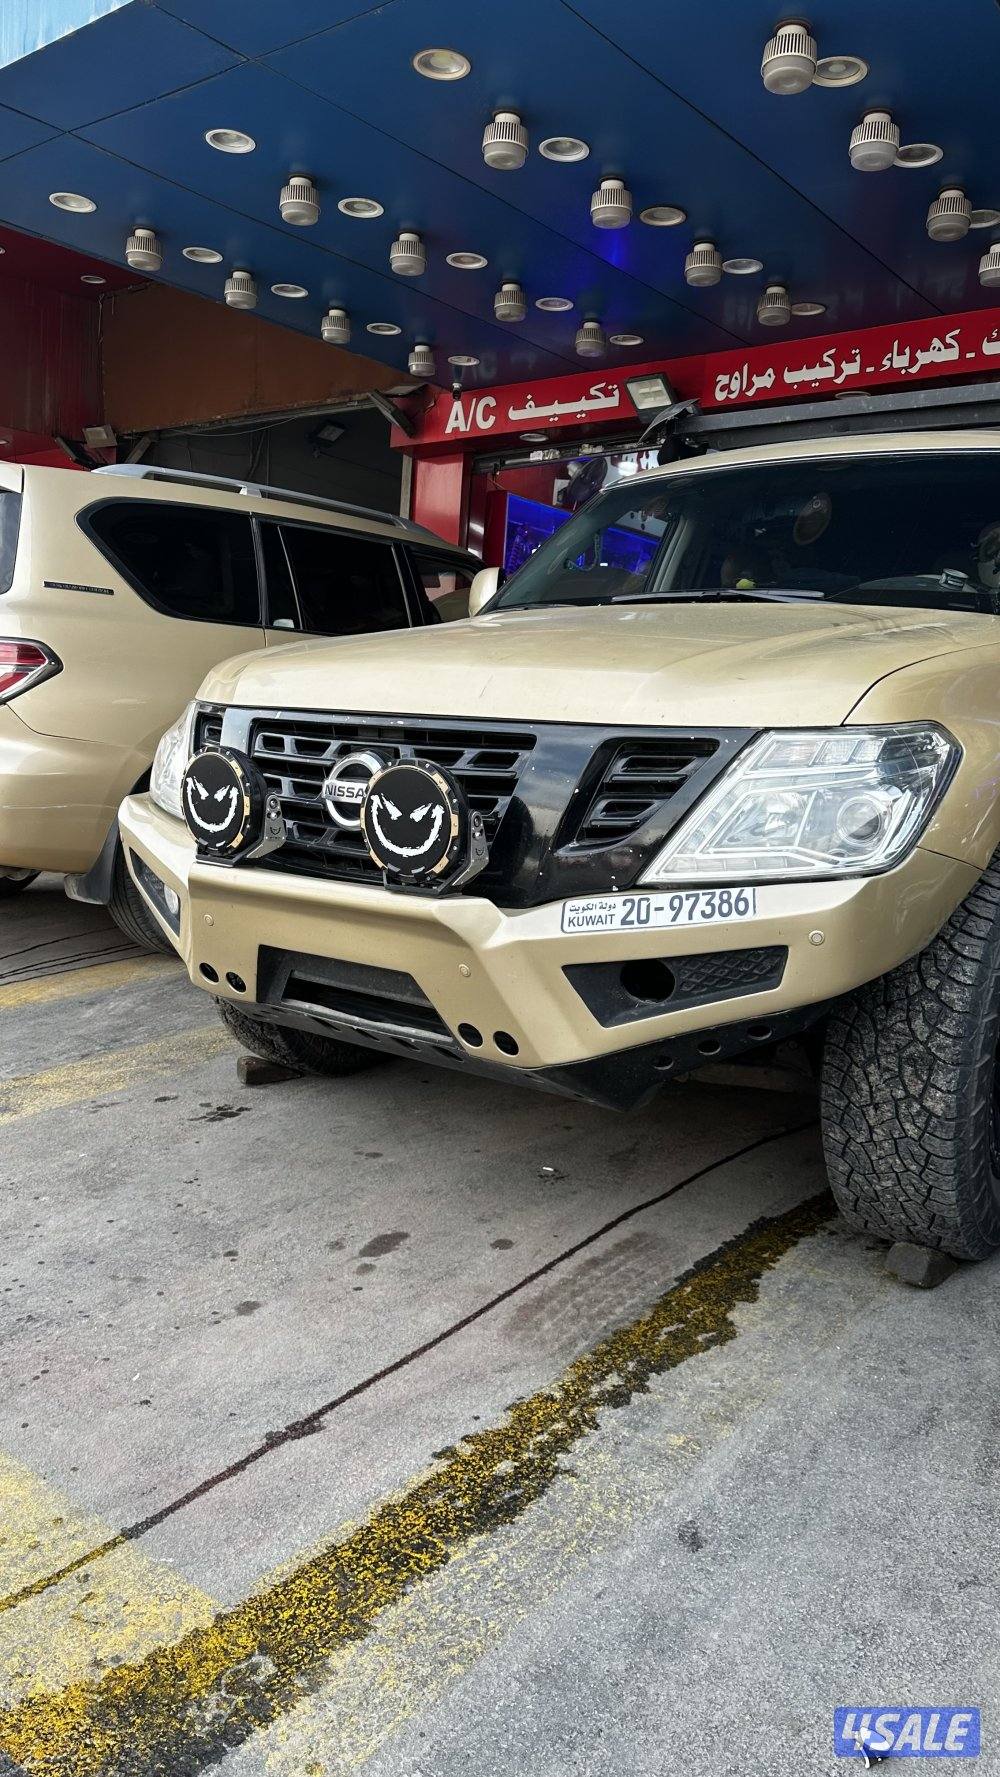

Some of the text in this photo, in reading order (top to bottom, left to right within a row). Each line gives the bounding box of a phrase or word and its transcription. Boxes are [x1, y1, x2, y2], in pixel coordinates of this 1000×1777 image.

[783, 348, 861, 388] تركيب
[879, 328, 961, 374] كهرباء
[714, 362, 776, 401] مراوح
[444, 396, 497, 434] A/C
[508, 381, 620, 422] تكييف
[325, 784, 366, 798] NISSA
[567, 914, 616, 928] KUWAIT
[569, 901, 616, 913] دولة الكويت
[620, 888, 750, 926] 20-97386
